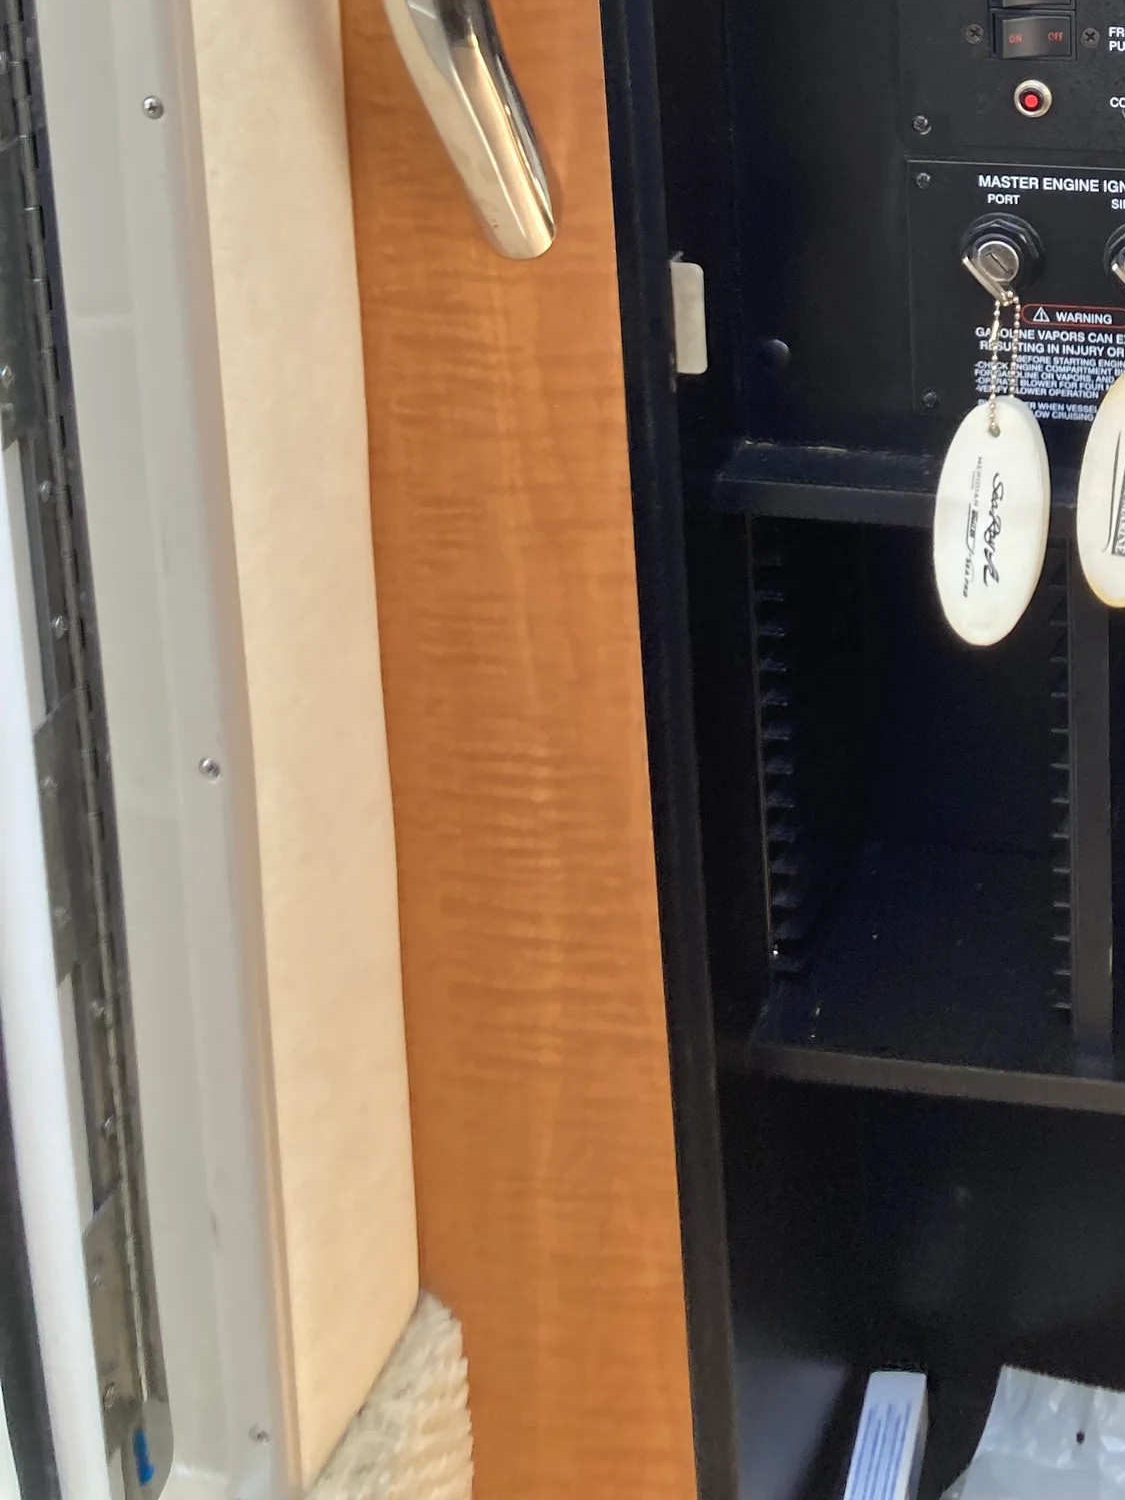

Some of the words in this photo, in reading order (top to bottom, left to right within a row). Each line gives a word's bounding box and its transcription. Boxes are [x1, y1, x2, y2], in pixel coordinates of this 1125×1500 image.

[1009, 34, 1022, 43] ON
[1048, 32, 1063, 41] OFF
[979, 175, 1038, 189] MASTER
[1043, 178, 1099, 192] ENGINE
[988, 194, 1020, 204] PORT
[1056, 312, 1112, 326] WARNING
[1037, 330, 1085, 342] VAPORS
[1088, 332, 1112, 343] CAN
[1048, 344, 1060, 354] IN
[1062, 344, 1104, 356] INJURY
[1107, 346, 1124, 357] OR
[1017, 355, 1052, 364] BEFORE
[1053, 356, 1096, 366] STARTING
[1046, 365, 1112, 376] COMPARTMENT
[1020, 380, 1057, 388] BLOWER
[1060, 382, 1078, 390] FOR
[1049, 388, 1099, 398] OPERATION
[1038, 402, 1064, 412] WHEN
[1052, 412, 1094, 421] CRUISING
[974, 456, 982, 506] MERIDIAN
